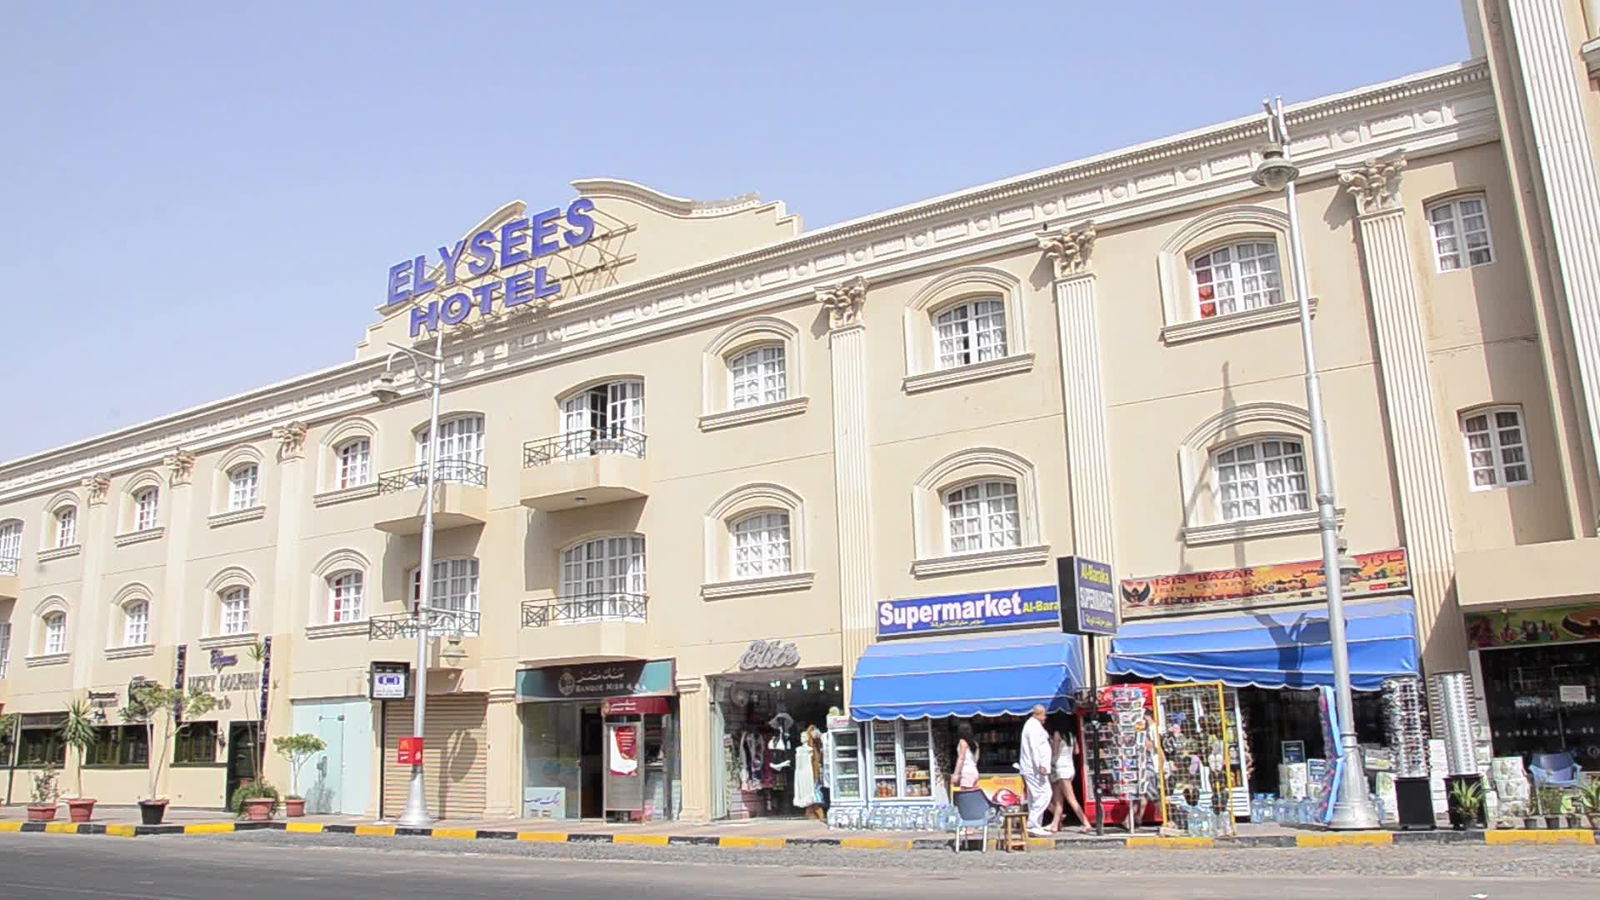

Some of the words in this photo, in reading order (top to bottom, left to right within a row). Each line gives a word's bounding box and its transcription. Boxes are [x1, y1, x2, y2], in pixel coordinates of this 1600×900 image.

[387, 199, 595, 307] ELYSEES
[410, 266, 561, 337] HOTEL
[1155, 576, 1186, 586] ISIS
[1198, 568, 1254, 581] BAZAR
[880, 591, 1021, 629] Supermarket
